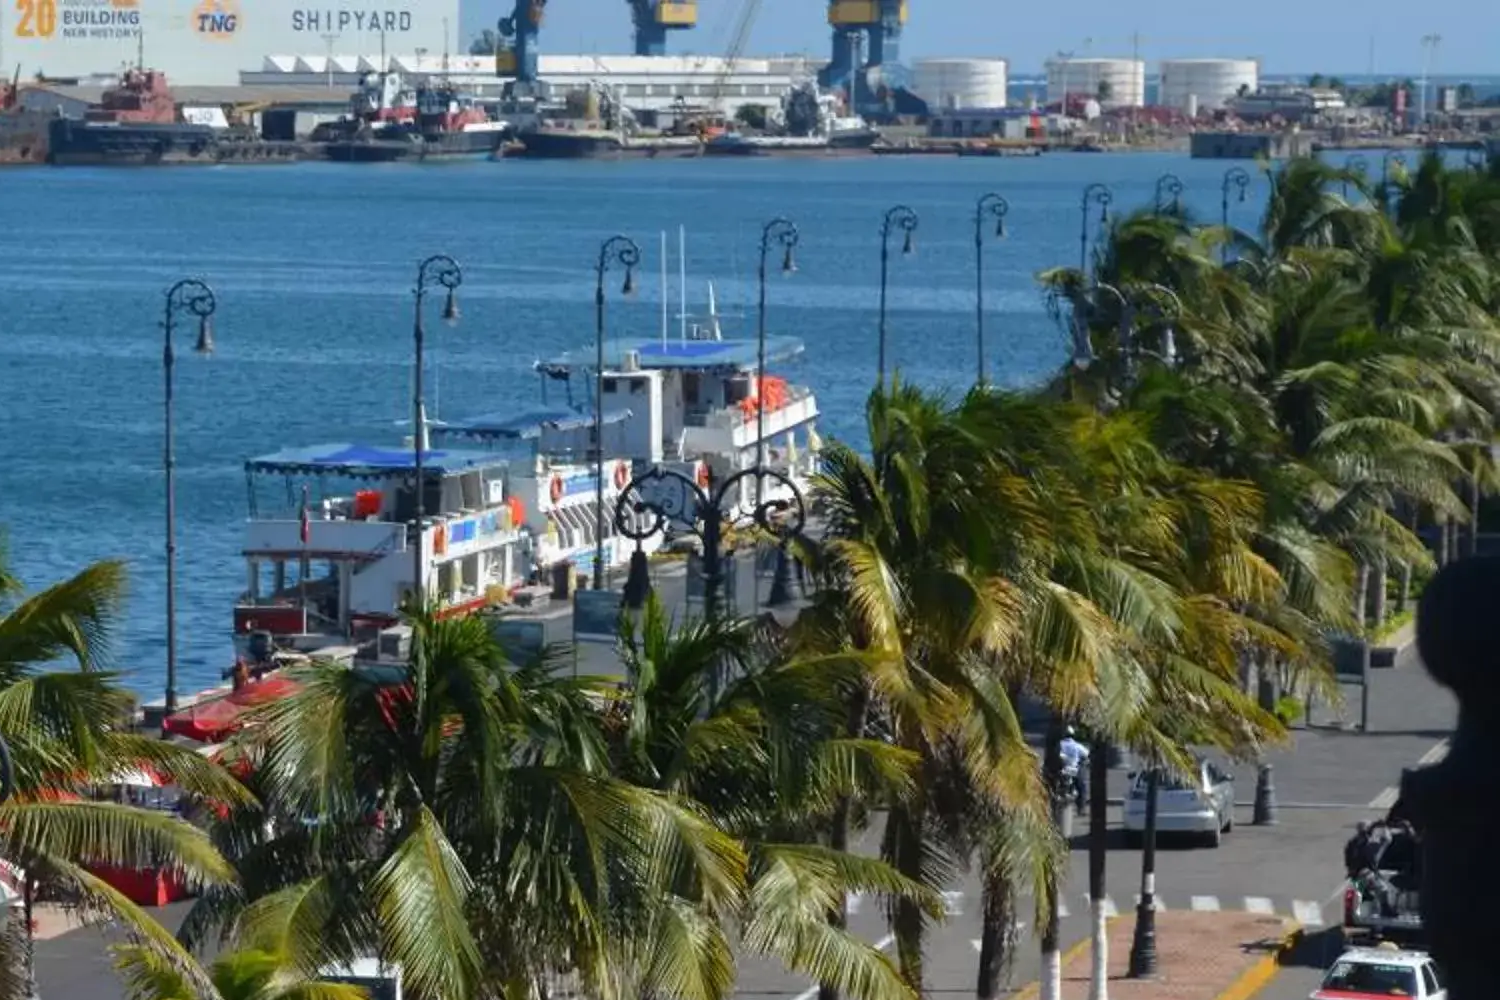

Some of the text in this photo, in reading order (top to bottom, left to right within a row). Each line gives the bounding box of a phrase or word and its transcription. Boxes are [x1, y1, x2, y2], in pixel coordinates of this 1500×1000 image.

[16, 0, 55, 37] 20
[63, 10, 140, 25] BUILDING
[197, 14, 237, 33] TNG
[292, 10, 412, 32] SHIPYARD
